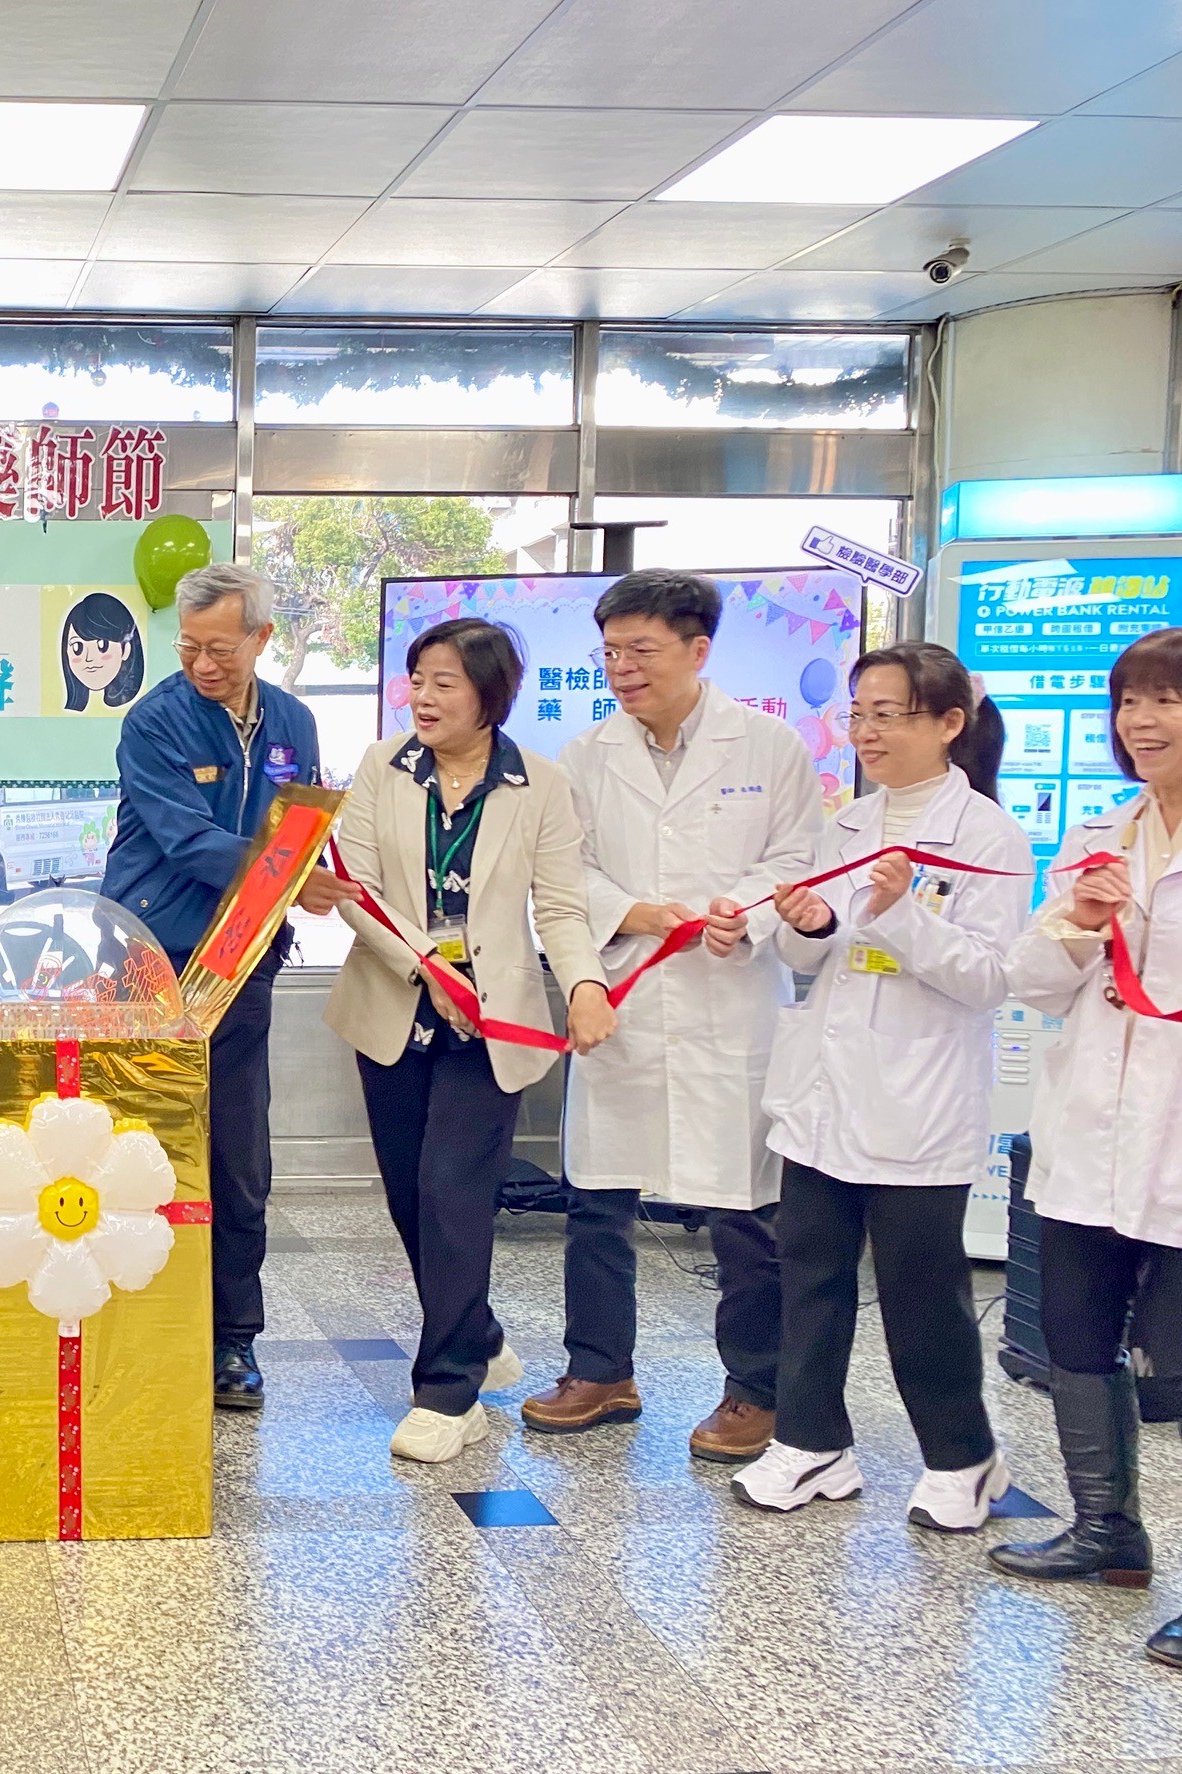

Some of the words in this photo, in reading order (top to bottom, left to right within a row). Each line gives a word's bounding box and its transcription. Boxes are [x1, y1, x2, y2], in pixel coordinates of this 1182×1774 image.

[836, 545, 909, 585] 檢驗醫學部
[1057, 604, 1103, 616] BANK
[1107, 603, 1171, 615] RENTAL
[1030, 675, 1106, 689] 借電步驟
